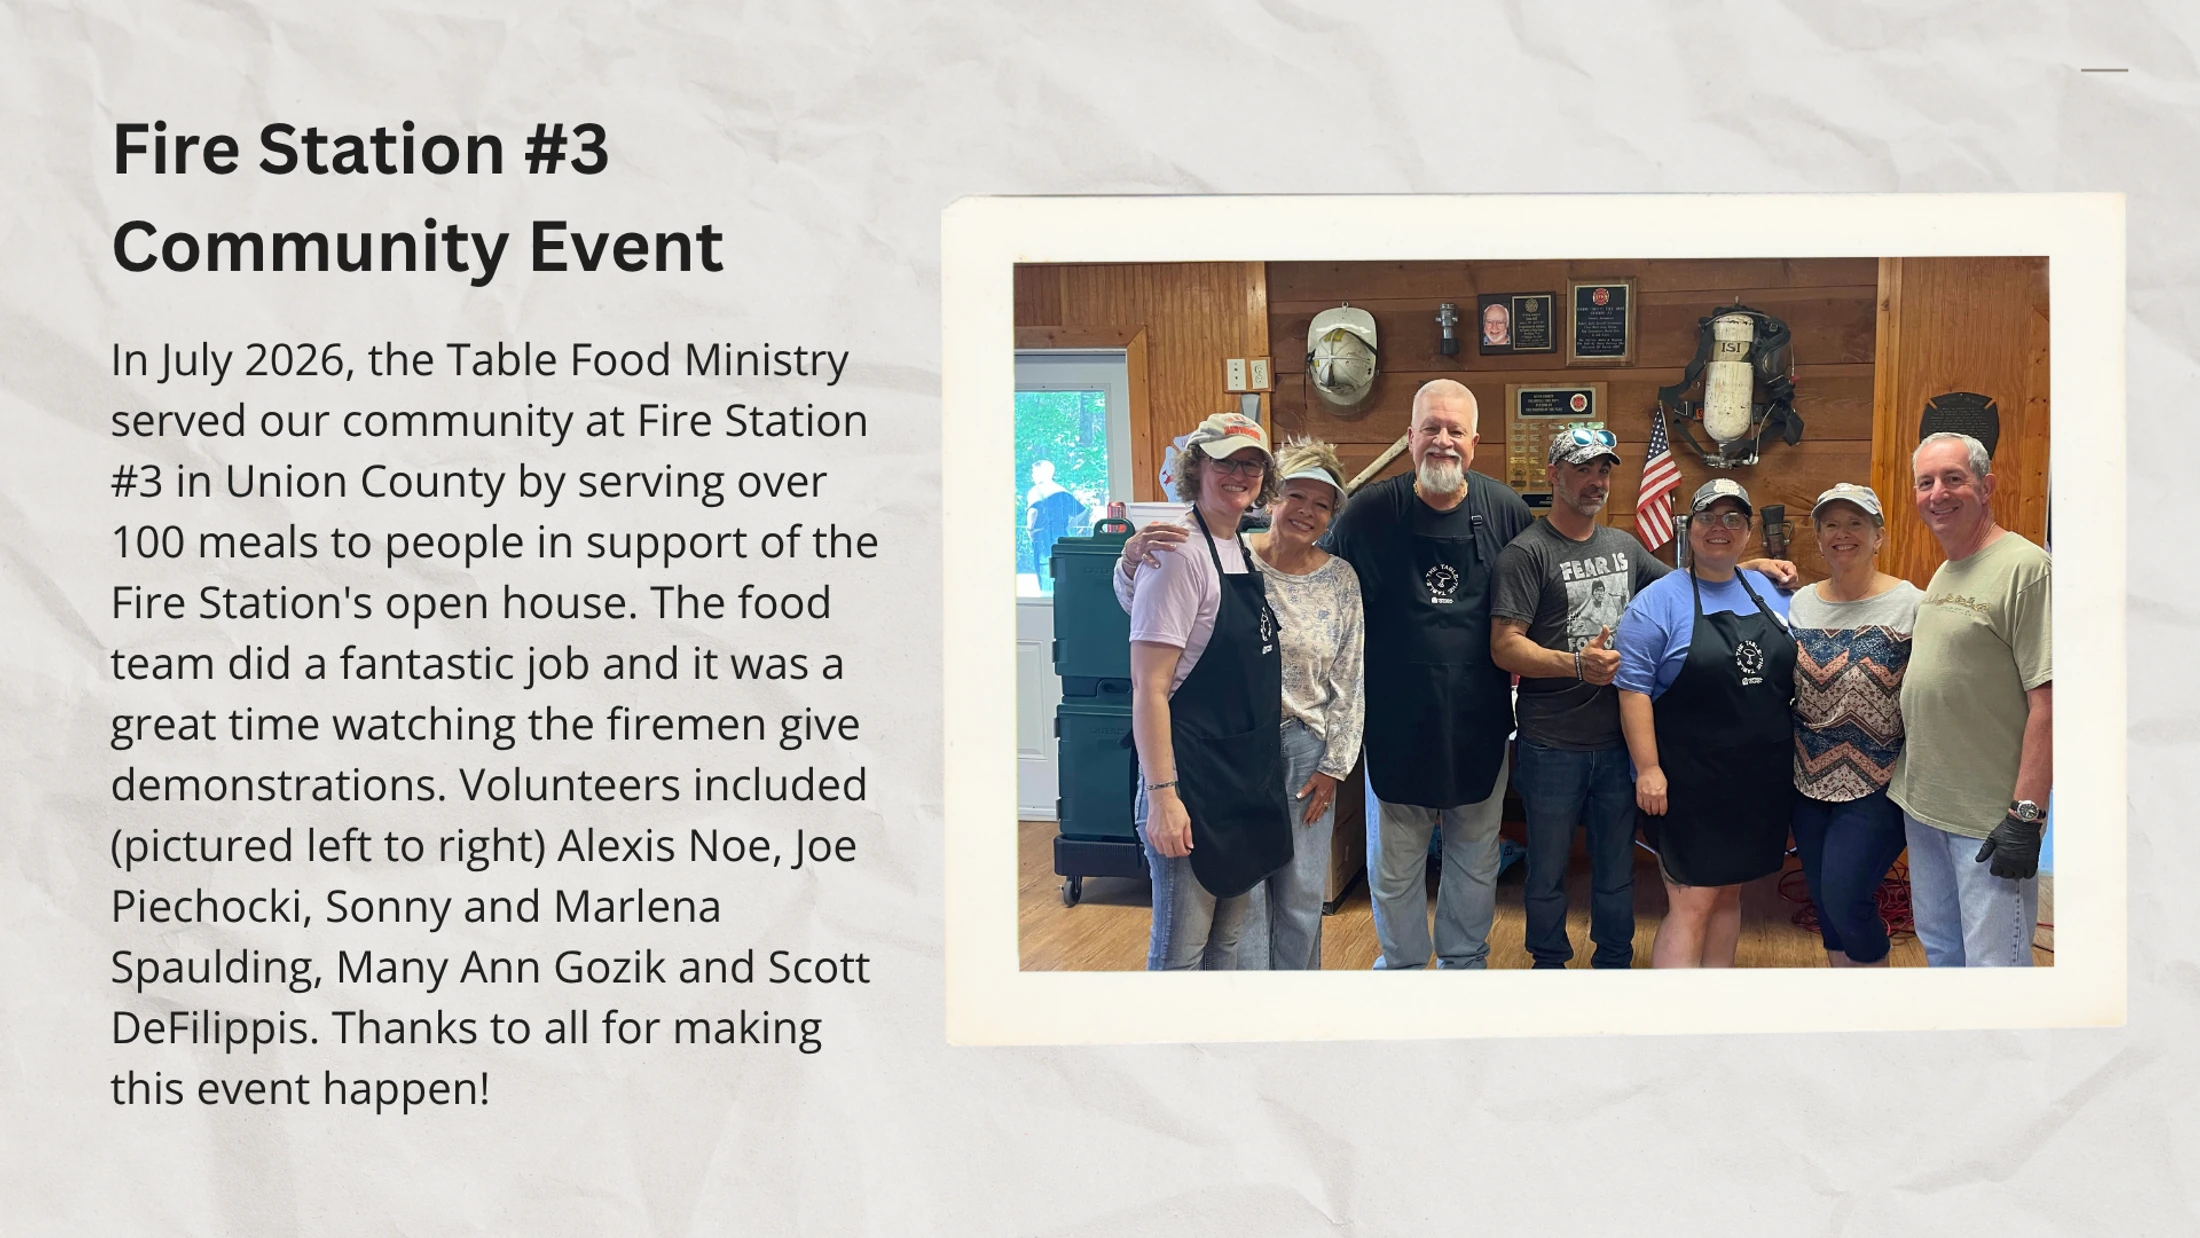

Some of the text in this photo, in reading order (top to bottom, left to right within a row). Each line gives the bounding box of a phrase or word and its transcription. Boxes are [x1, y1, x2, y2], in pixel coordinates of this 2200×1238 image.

[1721, 342, 1742, 353] ISI
[1425, 563, 1460, 580] THE TABLE
[1559, 552, 1629, 581] FEAR IS
